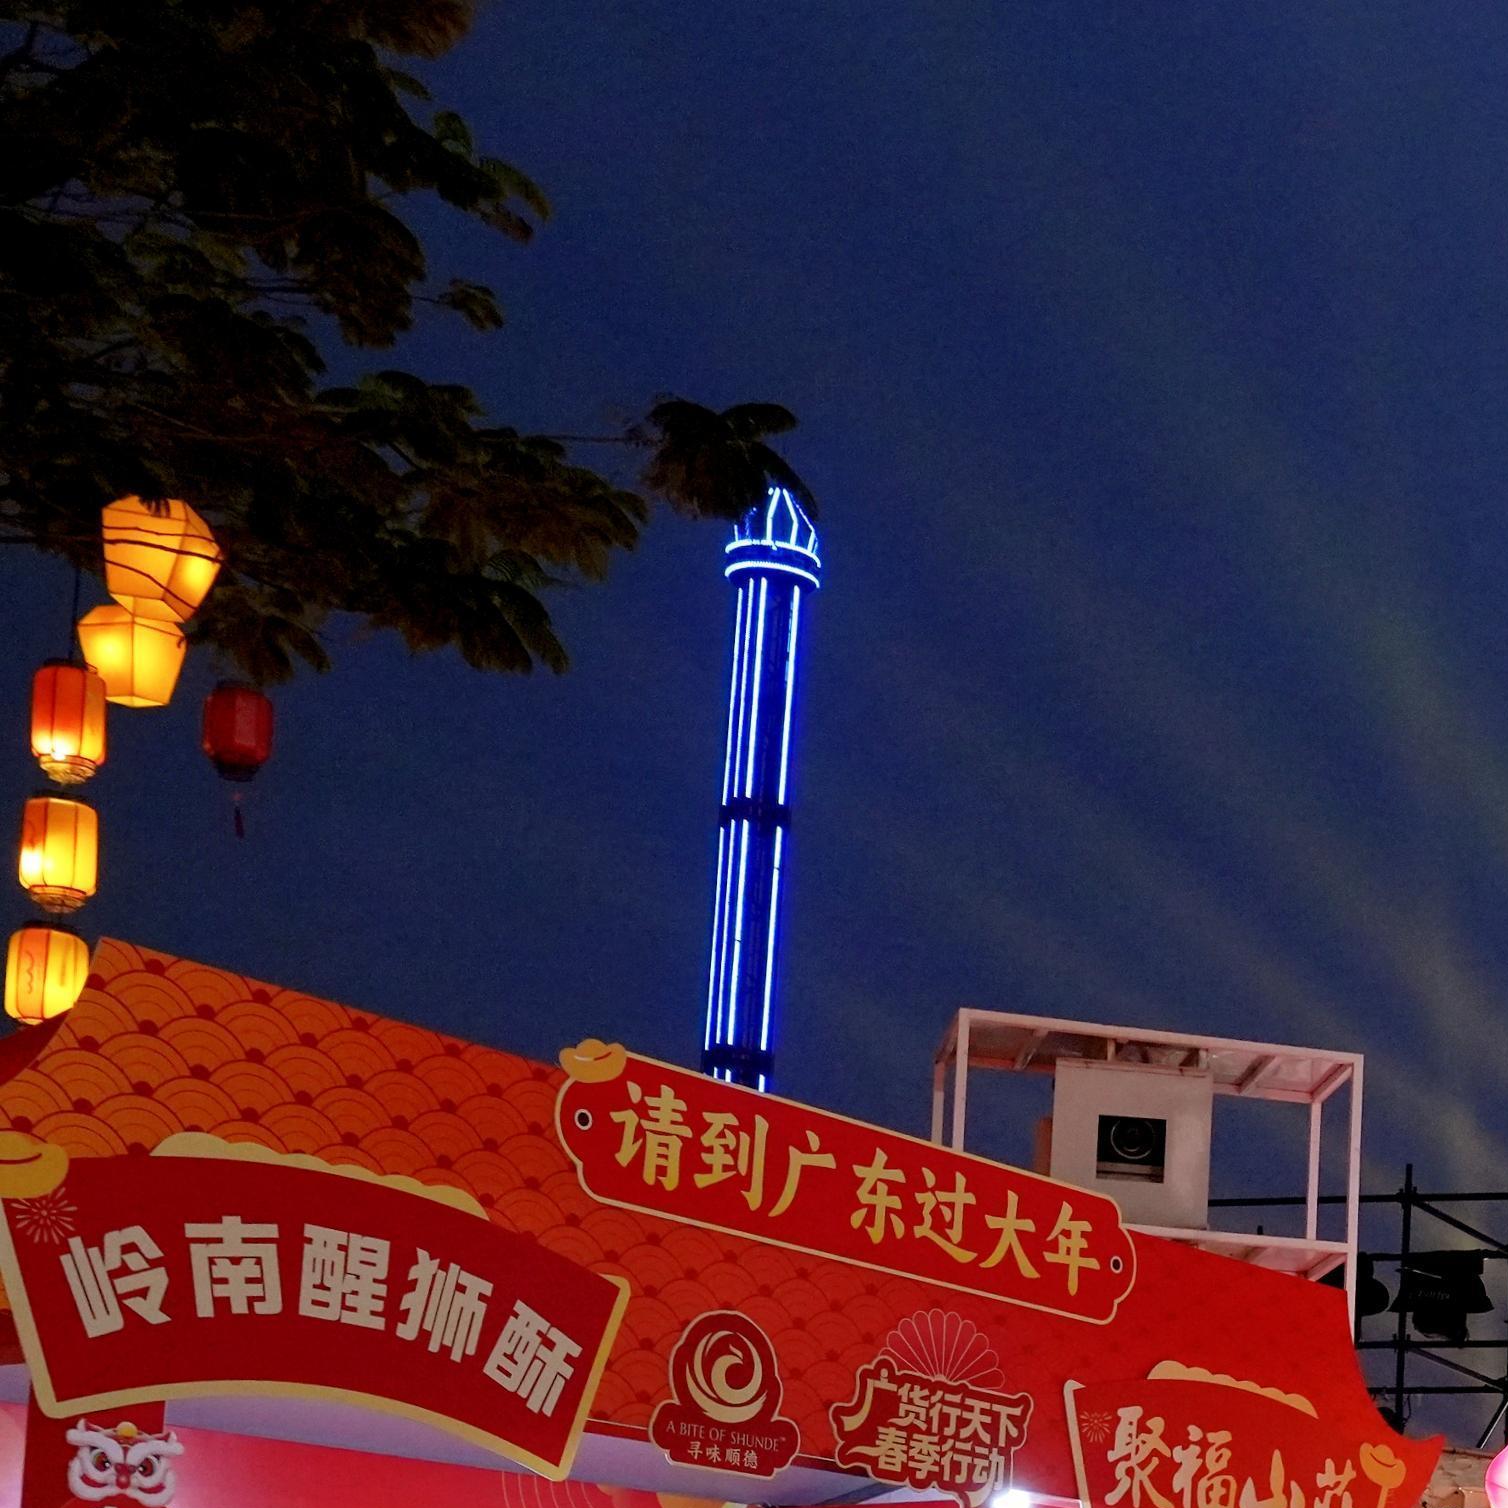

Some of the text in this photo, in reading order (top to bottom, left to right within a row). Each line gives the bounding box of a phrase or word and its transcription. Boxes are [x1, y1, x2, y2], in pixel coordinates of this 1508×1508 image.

[611, 1080, 1102, 1296] 请到广东过大年
[59, 1215, 583, 1416] 岭南醒狮酥
[667, 1421, 676, 1435] A
[680, 1423, 707, 1439] BITE
[710, 1427, 726, 1442] OF
[843, 1369, 1022, 1447] 广货行天下
[687, 1441, 759, 1469] 寻味顺德
[848, 1426, 1005, 1508] 春季行动
